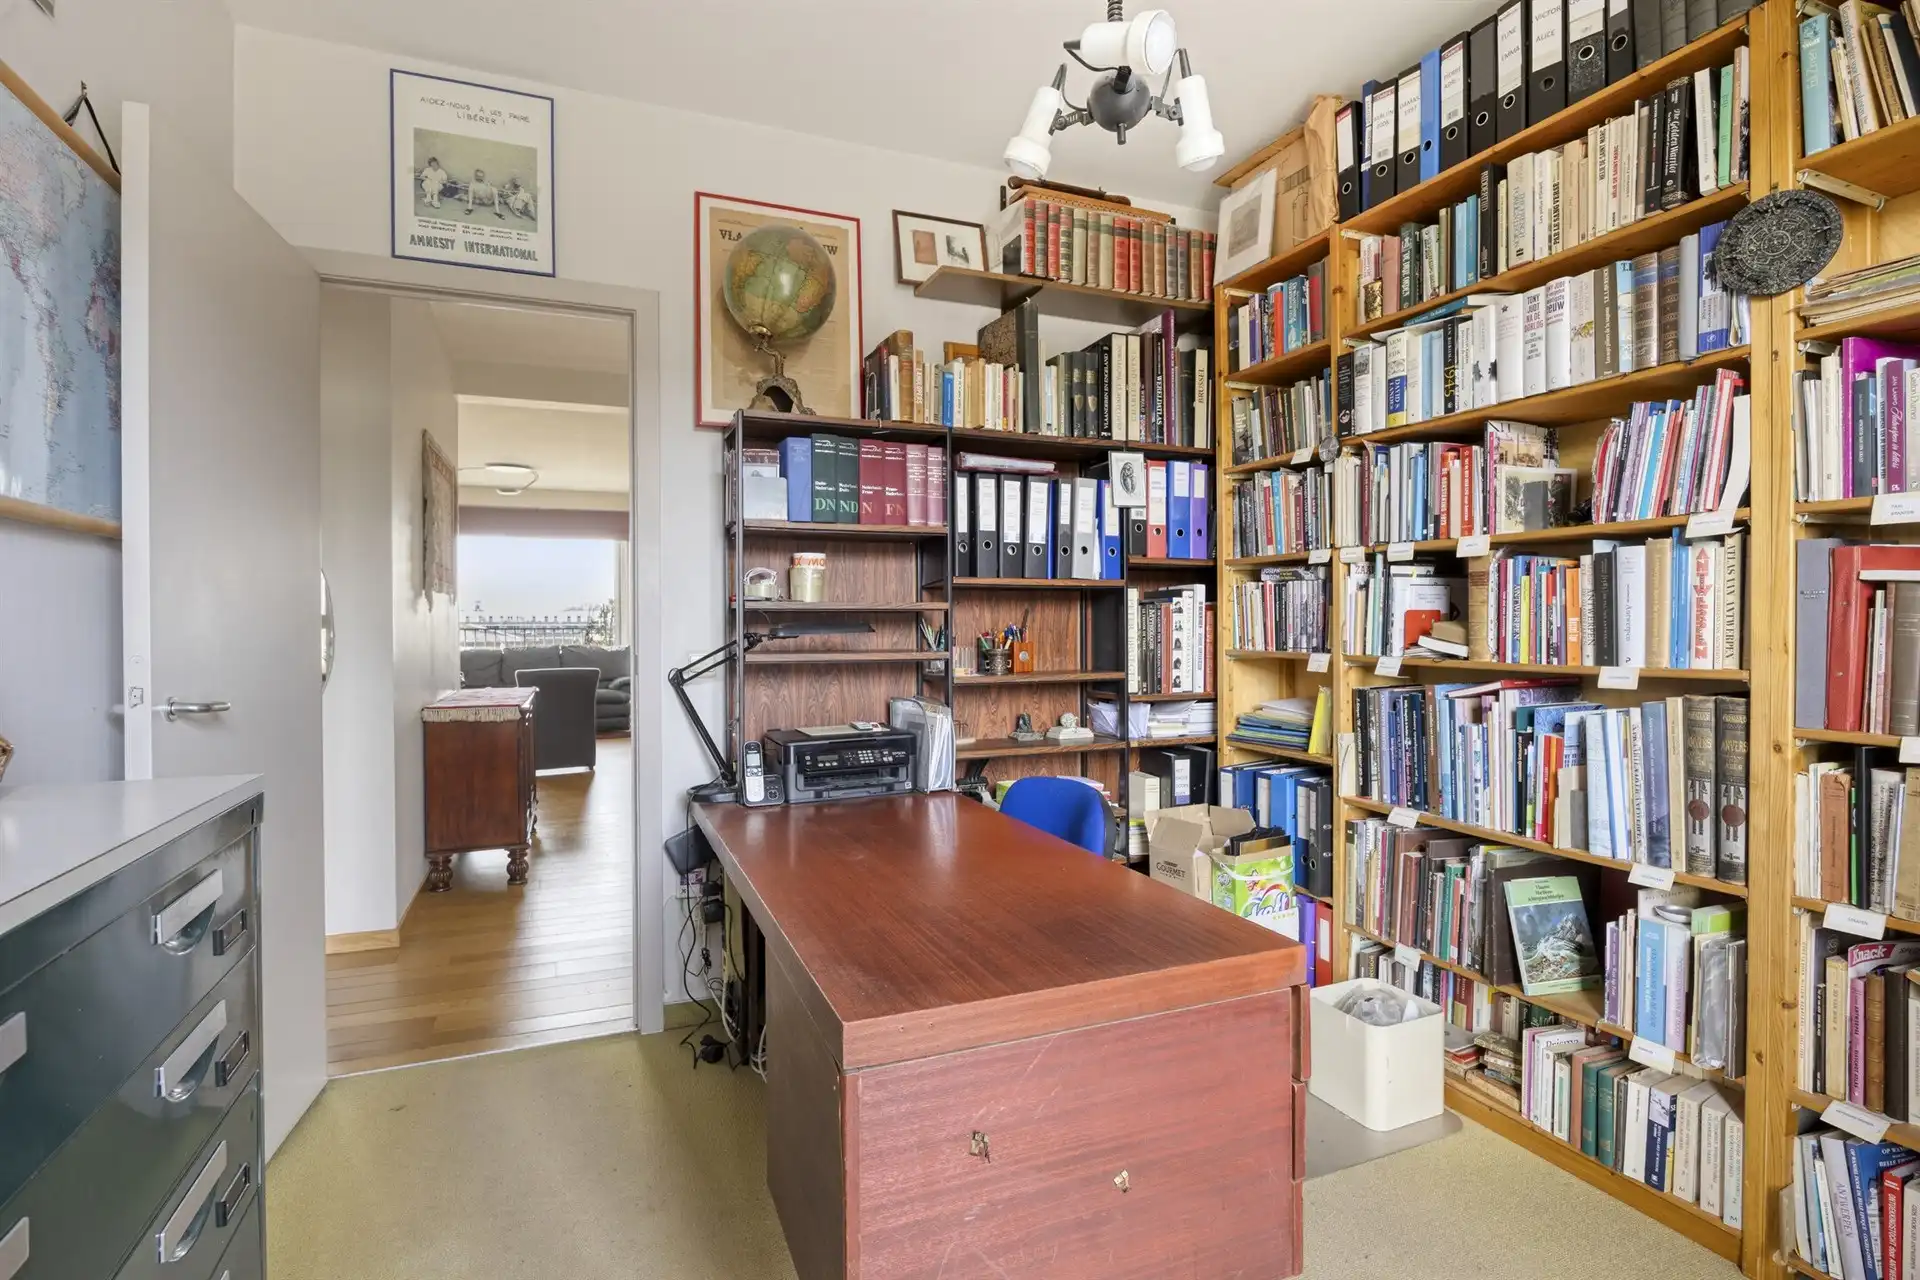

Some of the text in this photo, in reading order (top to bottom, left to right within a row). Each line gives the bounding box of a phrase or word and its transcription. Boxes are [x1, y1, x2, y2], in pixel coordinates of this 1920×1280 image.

[1535, 6, 1561, 21] VICTOR
[1536, 29, 1556, 43] ALICE
[420, 96, 471, 111] AIDEZ-NOUS
[509, 112, 531, 123] FAIRE
[457, 112, 497, 125] LIBÉRER
[1669, 121, 1680, 145] Golden
[1669, 146, 1678, 174] Warrior
[410, 234, 538, 261] AMNESTY INTERNATIONAL
[1527, 294, 1540, 304] TONY
[1527, 304, 1540, 313] JUDT
[1524, 321, 1544, 332] OORLOG
[1527, 312, 1541, 323] NA DE
[1444, 365, 1455, 397] 1945
[1910, 372, 1918, 395] Gaston
[1888, 407, 1902, 443] Antwerpen
[814, 497, 836, 511] DN
[839, 501, 858, 514] ND
[1513, 584, 1521, 640] ANTWERPEN
[1726, 543, 1736, 659] ATLAS VAN ANTWERPEN
[1587, 588, 1596, 646] ANTWERPEN
[1624, 604, 1632, 641] Antwerpen
[1156, 862, 1185, 878] GOURMET
[1852, 947, 1883, 966] Knack
[1836, 1182, 1853, 1238] ANTWERPEN
[1888, 1194, 1897, 1246] ONTDEKKINGSTOCHT
